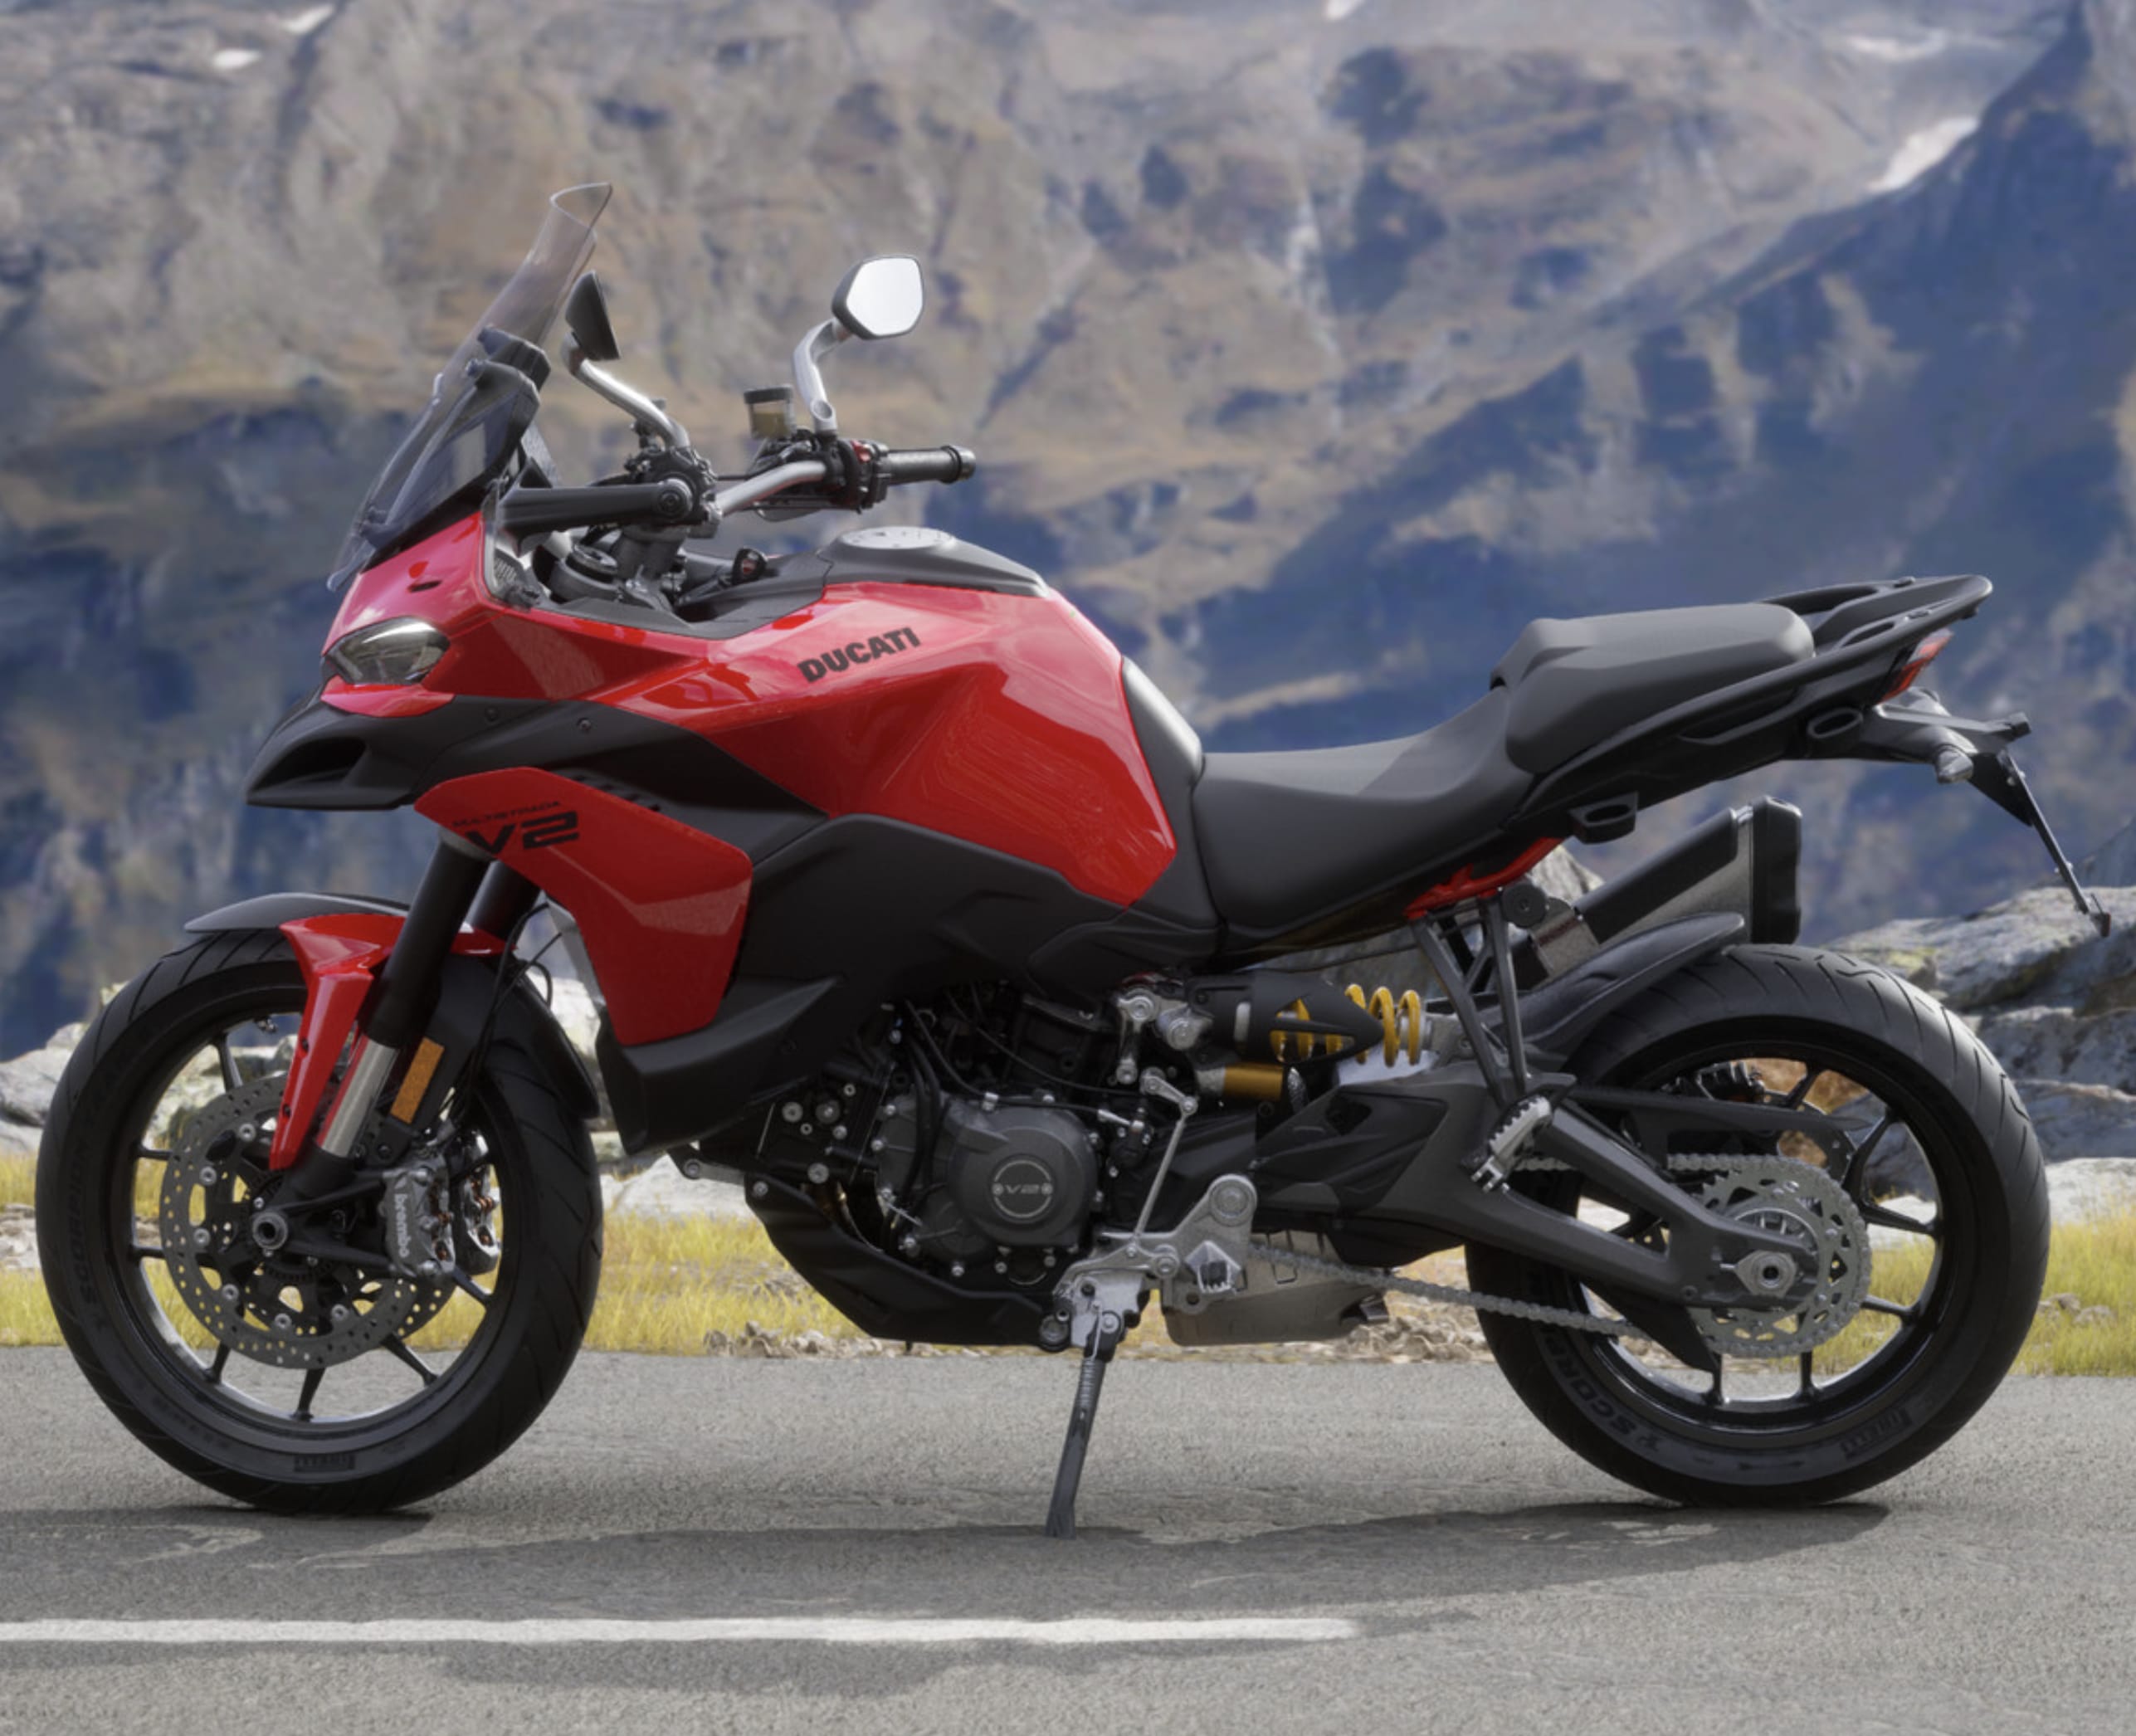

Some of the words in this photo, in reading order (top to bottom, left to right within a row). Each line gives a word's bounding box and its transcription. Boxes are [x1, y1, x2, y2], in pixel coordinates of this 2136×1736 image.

[797, 627, 921, 682] DUCATI
[466, 811, 579, 856] V2
[1005, 1183, 1040, 1194] V2
[394, 1192, 412, 1259] brembo
